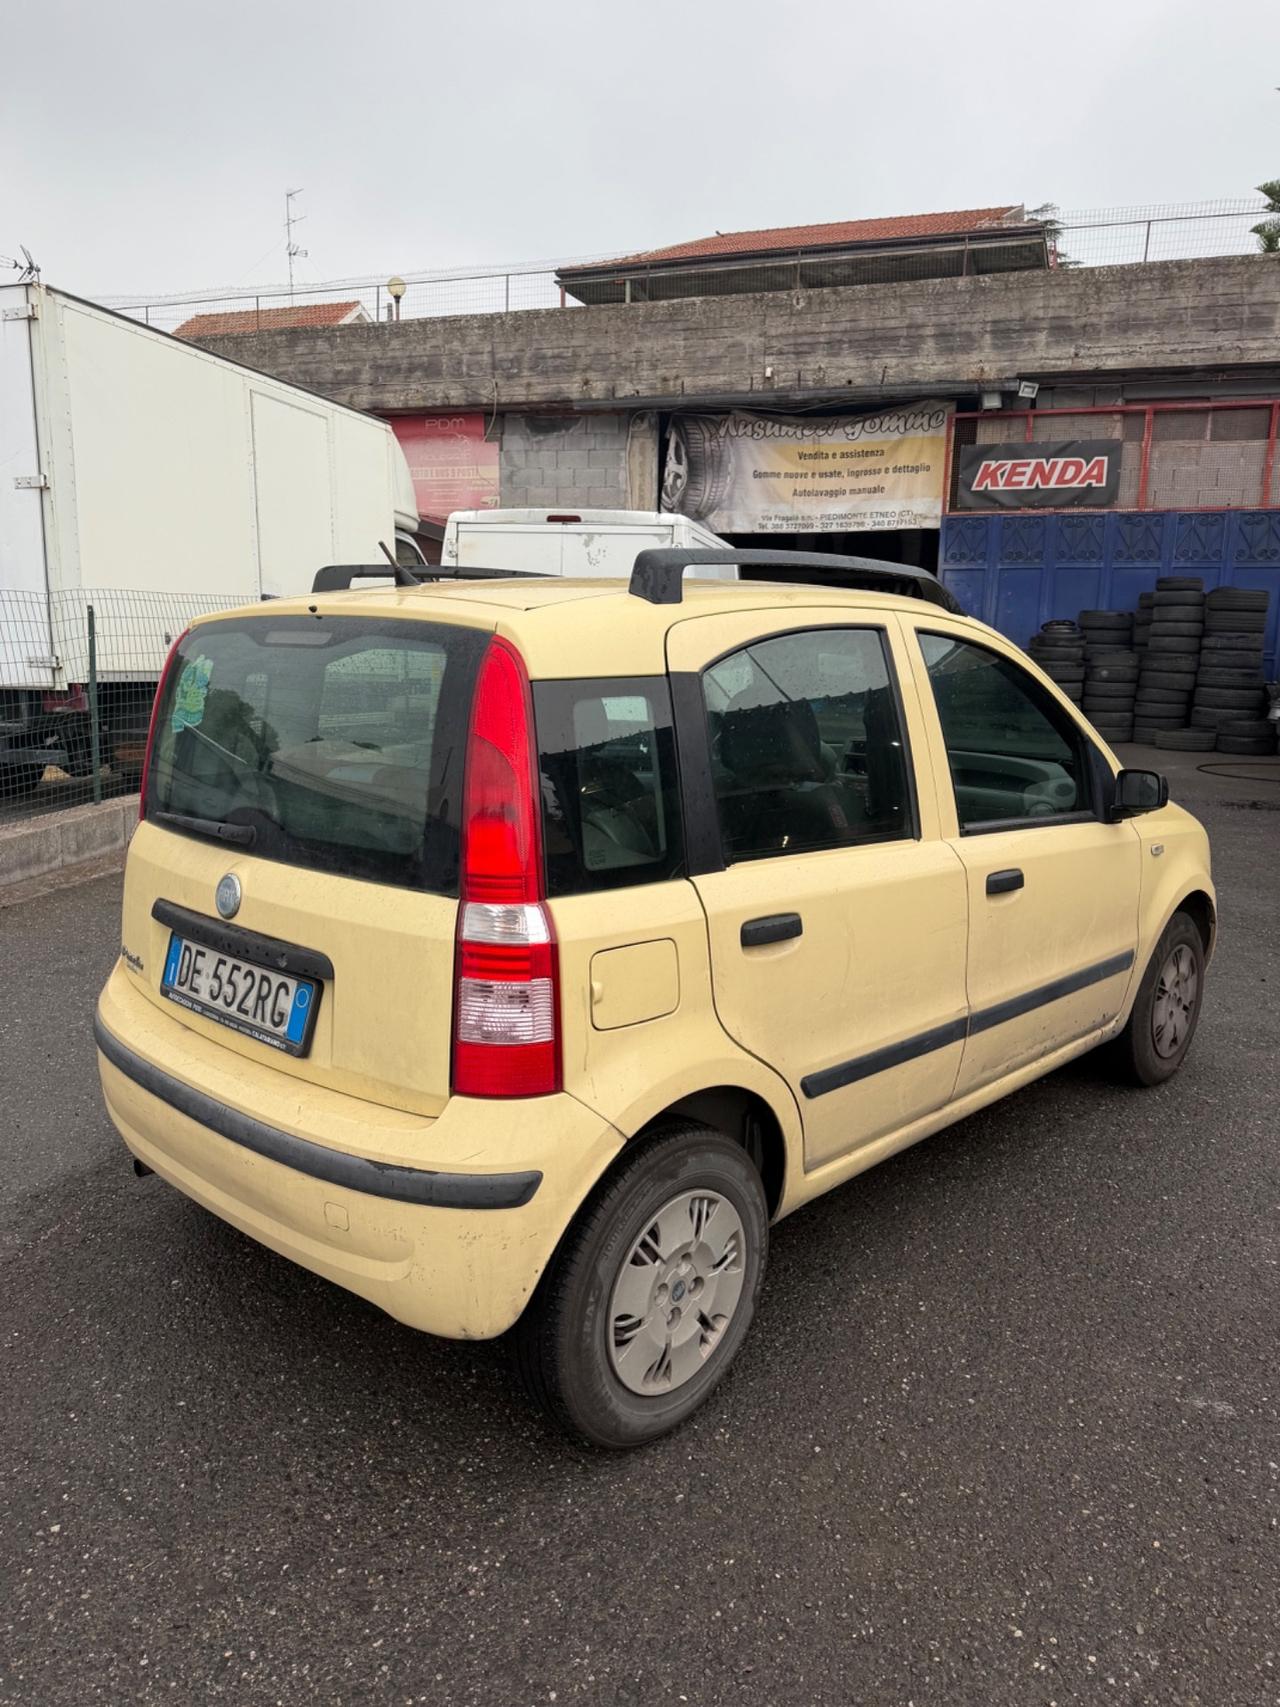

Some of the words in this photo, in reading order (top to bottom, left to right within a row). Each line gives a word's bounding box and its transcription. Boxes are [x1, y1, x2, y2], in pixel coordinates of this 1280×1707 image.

[845, 409, 946, 441] gomme
[797, 450, 830, 461] Vendita
[831, 452, 837, 460] e
[839, 449, 885, 460] assistenza
[752, 469, 782, 480] Gomme
[783, 470, 809, 480] nuove
[811, 471, 817, 479] e
[818, 469, 845, 479] usate,
[847, 467, 882, 479] ingrosso
[884, 466, 889, 475] e
[892, 463, 931, 474] dettaglio
[971, 455, 1109, 491] KENDA
[792, 487, 847, 498] Autolavaggio
[848, 485, 886, 495] manuale
[819, 512, 868, 521] PIEDIMONTE
[870, 511, 896, 519] ETNEO
[177, 944, 206, 994] DE
[209, 957, 290, 1028] 552RG
